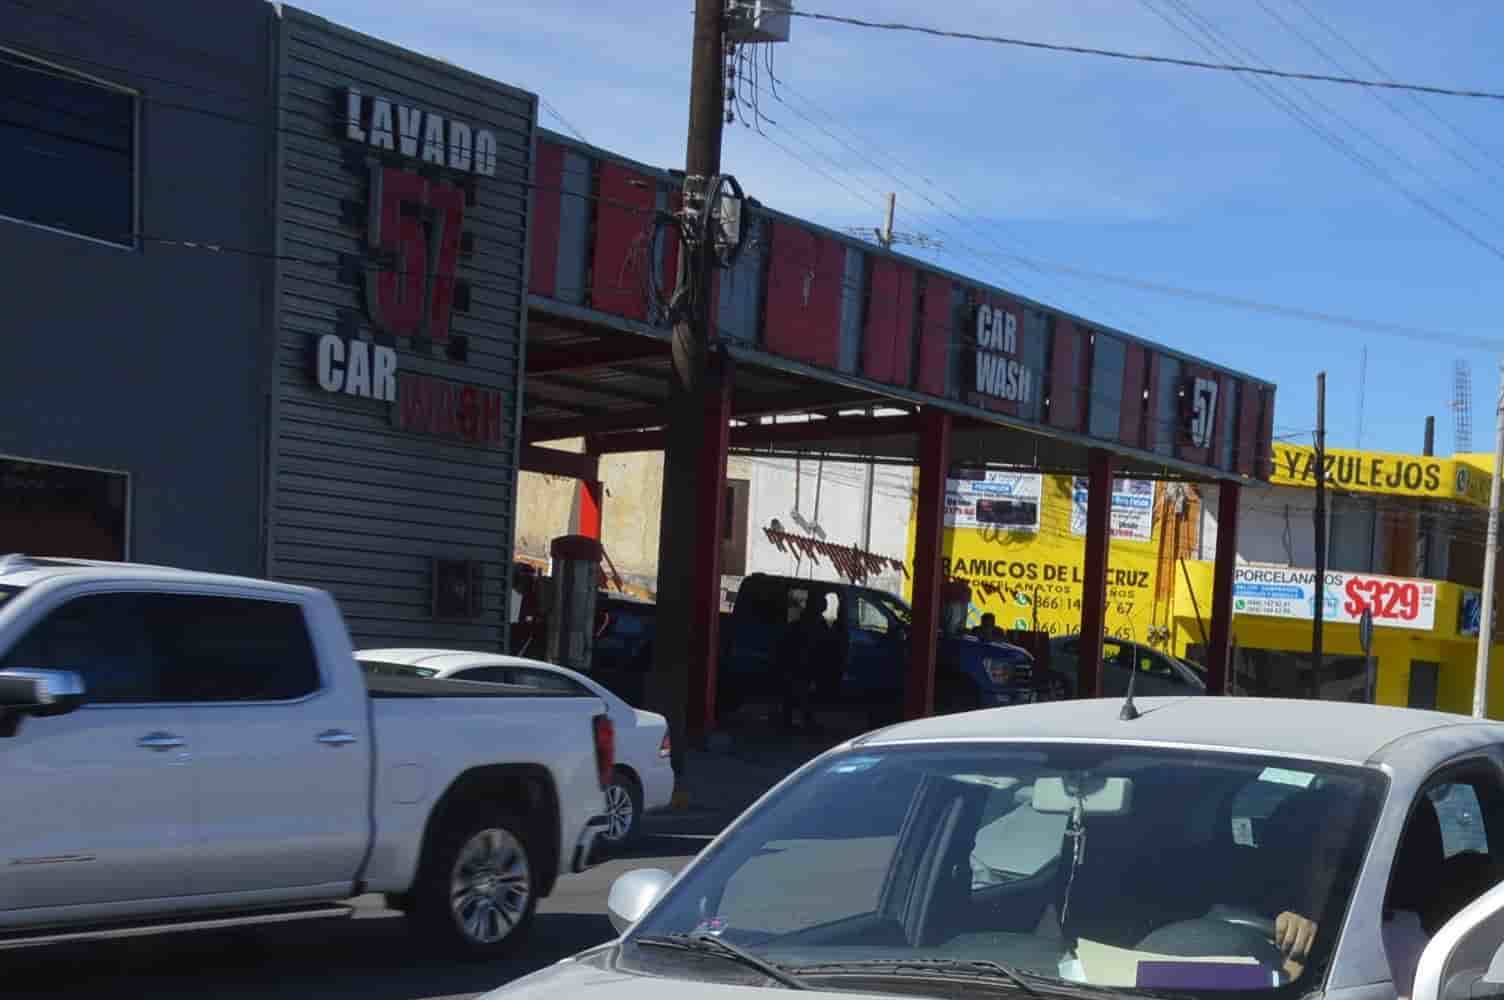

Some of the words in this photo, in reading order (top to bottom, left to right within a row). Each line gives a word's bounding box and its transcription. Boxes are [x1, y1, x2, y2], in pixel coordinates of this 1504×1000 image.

[347, 88, 497, 177] LAVADO
[371, 166, 465, 343] 57
[975, 303, 1017, 353] CAR
[317, 333, 398, 401] CAR
[975, 350, 1032, 405] WASH
[1191, 376, 1218, 449] 57
[944, 558, 1038, 580] RAMICOS
[1044, 564, 1068, 583] DE
[1234, 568, 1343, 587] PORCELANAOS
[1344, 577, 1419, 621] $329
